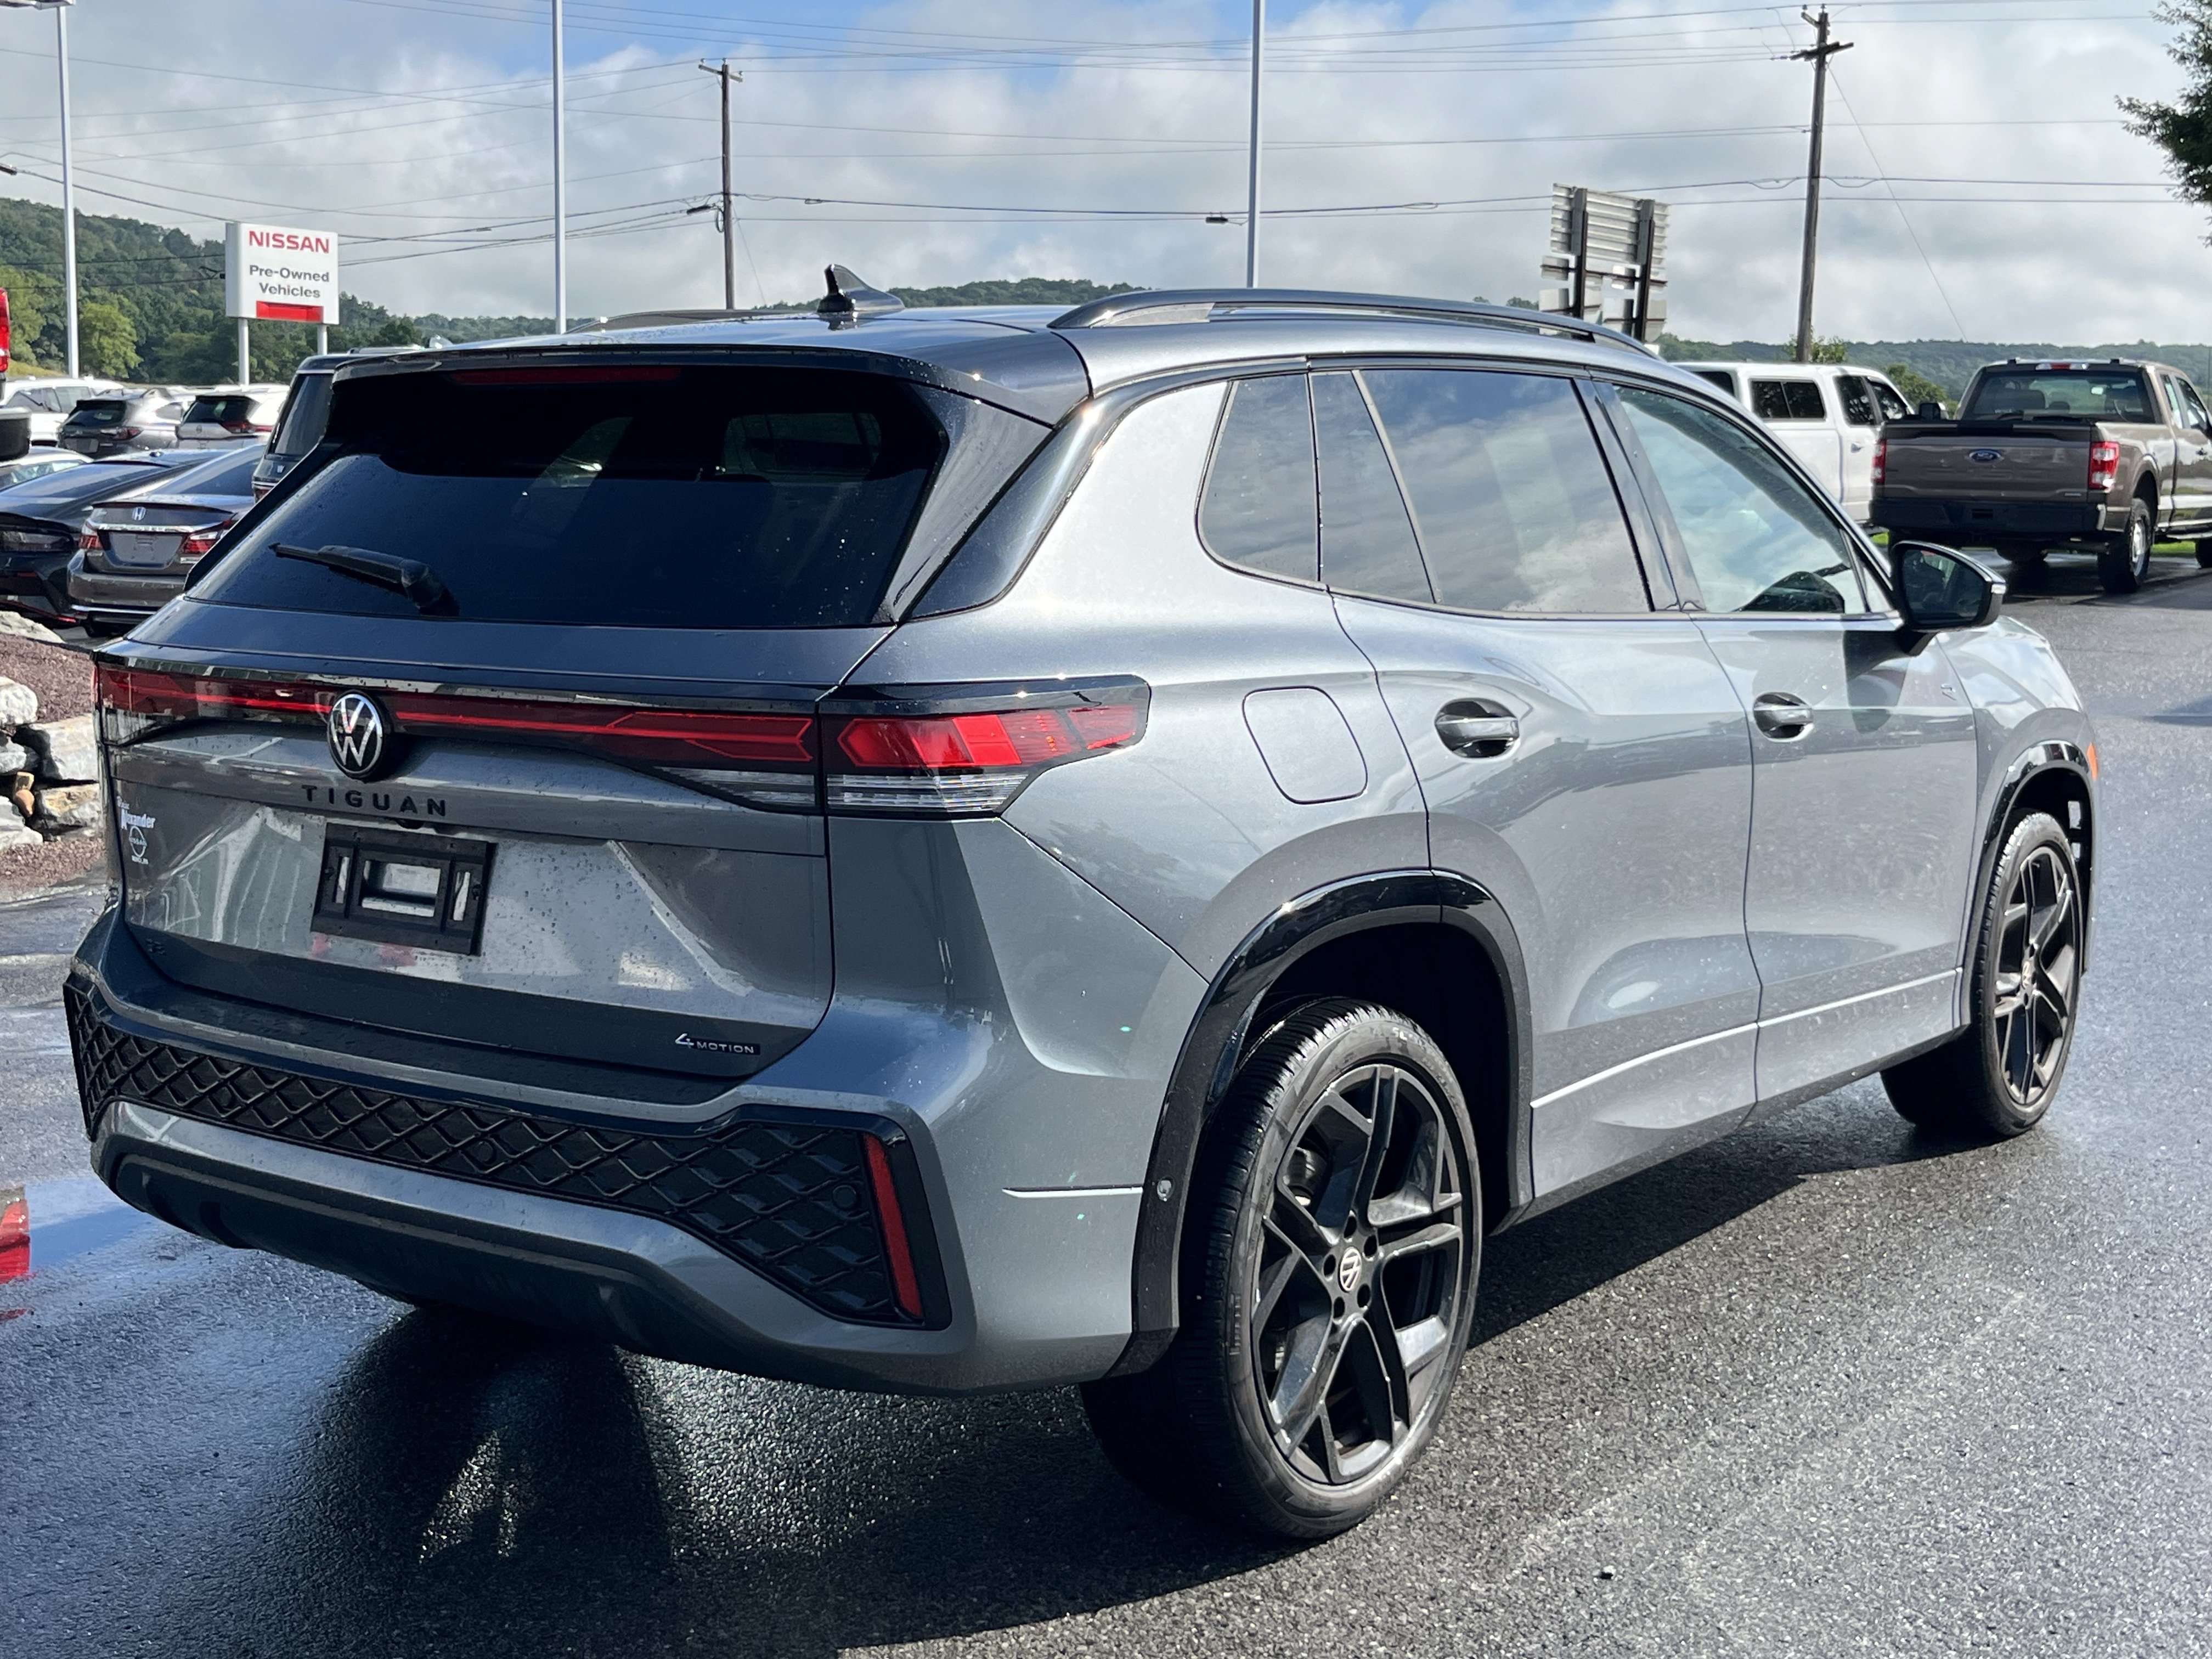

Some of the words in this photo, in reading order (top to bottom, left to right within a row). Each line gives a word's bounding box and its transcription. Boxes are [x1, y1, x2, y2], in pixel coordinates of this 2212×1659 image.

[249, 230, 329, 253] NISSAN
[249, 264, 330, 282] Pre-Owned
[259, 282, 320, 298] Vehicles
[302, 785, 445, 816] TIGUAN
[675, 1032, 755, 1054] 4MOTION
